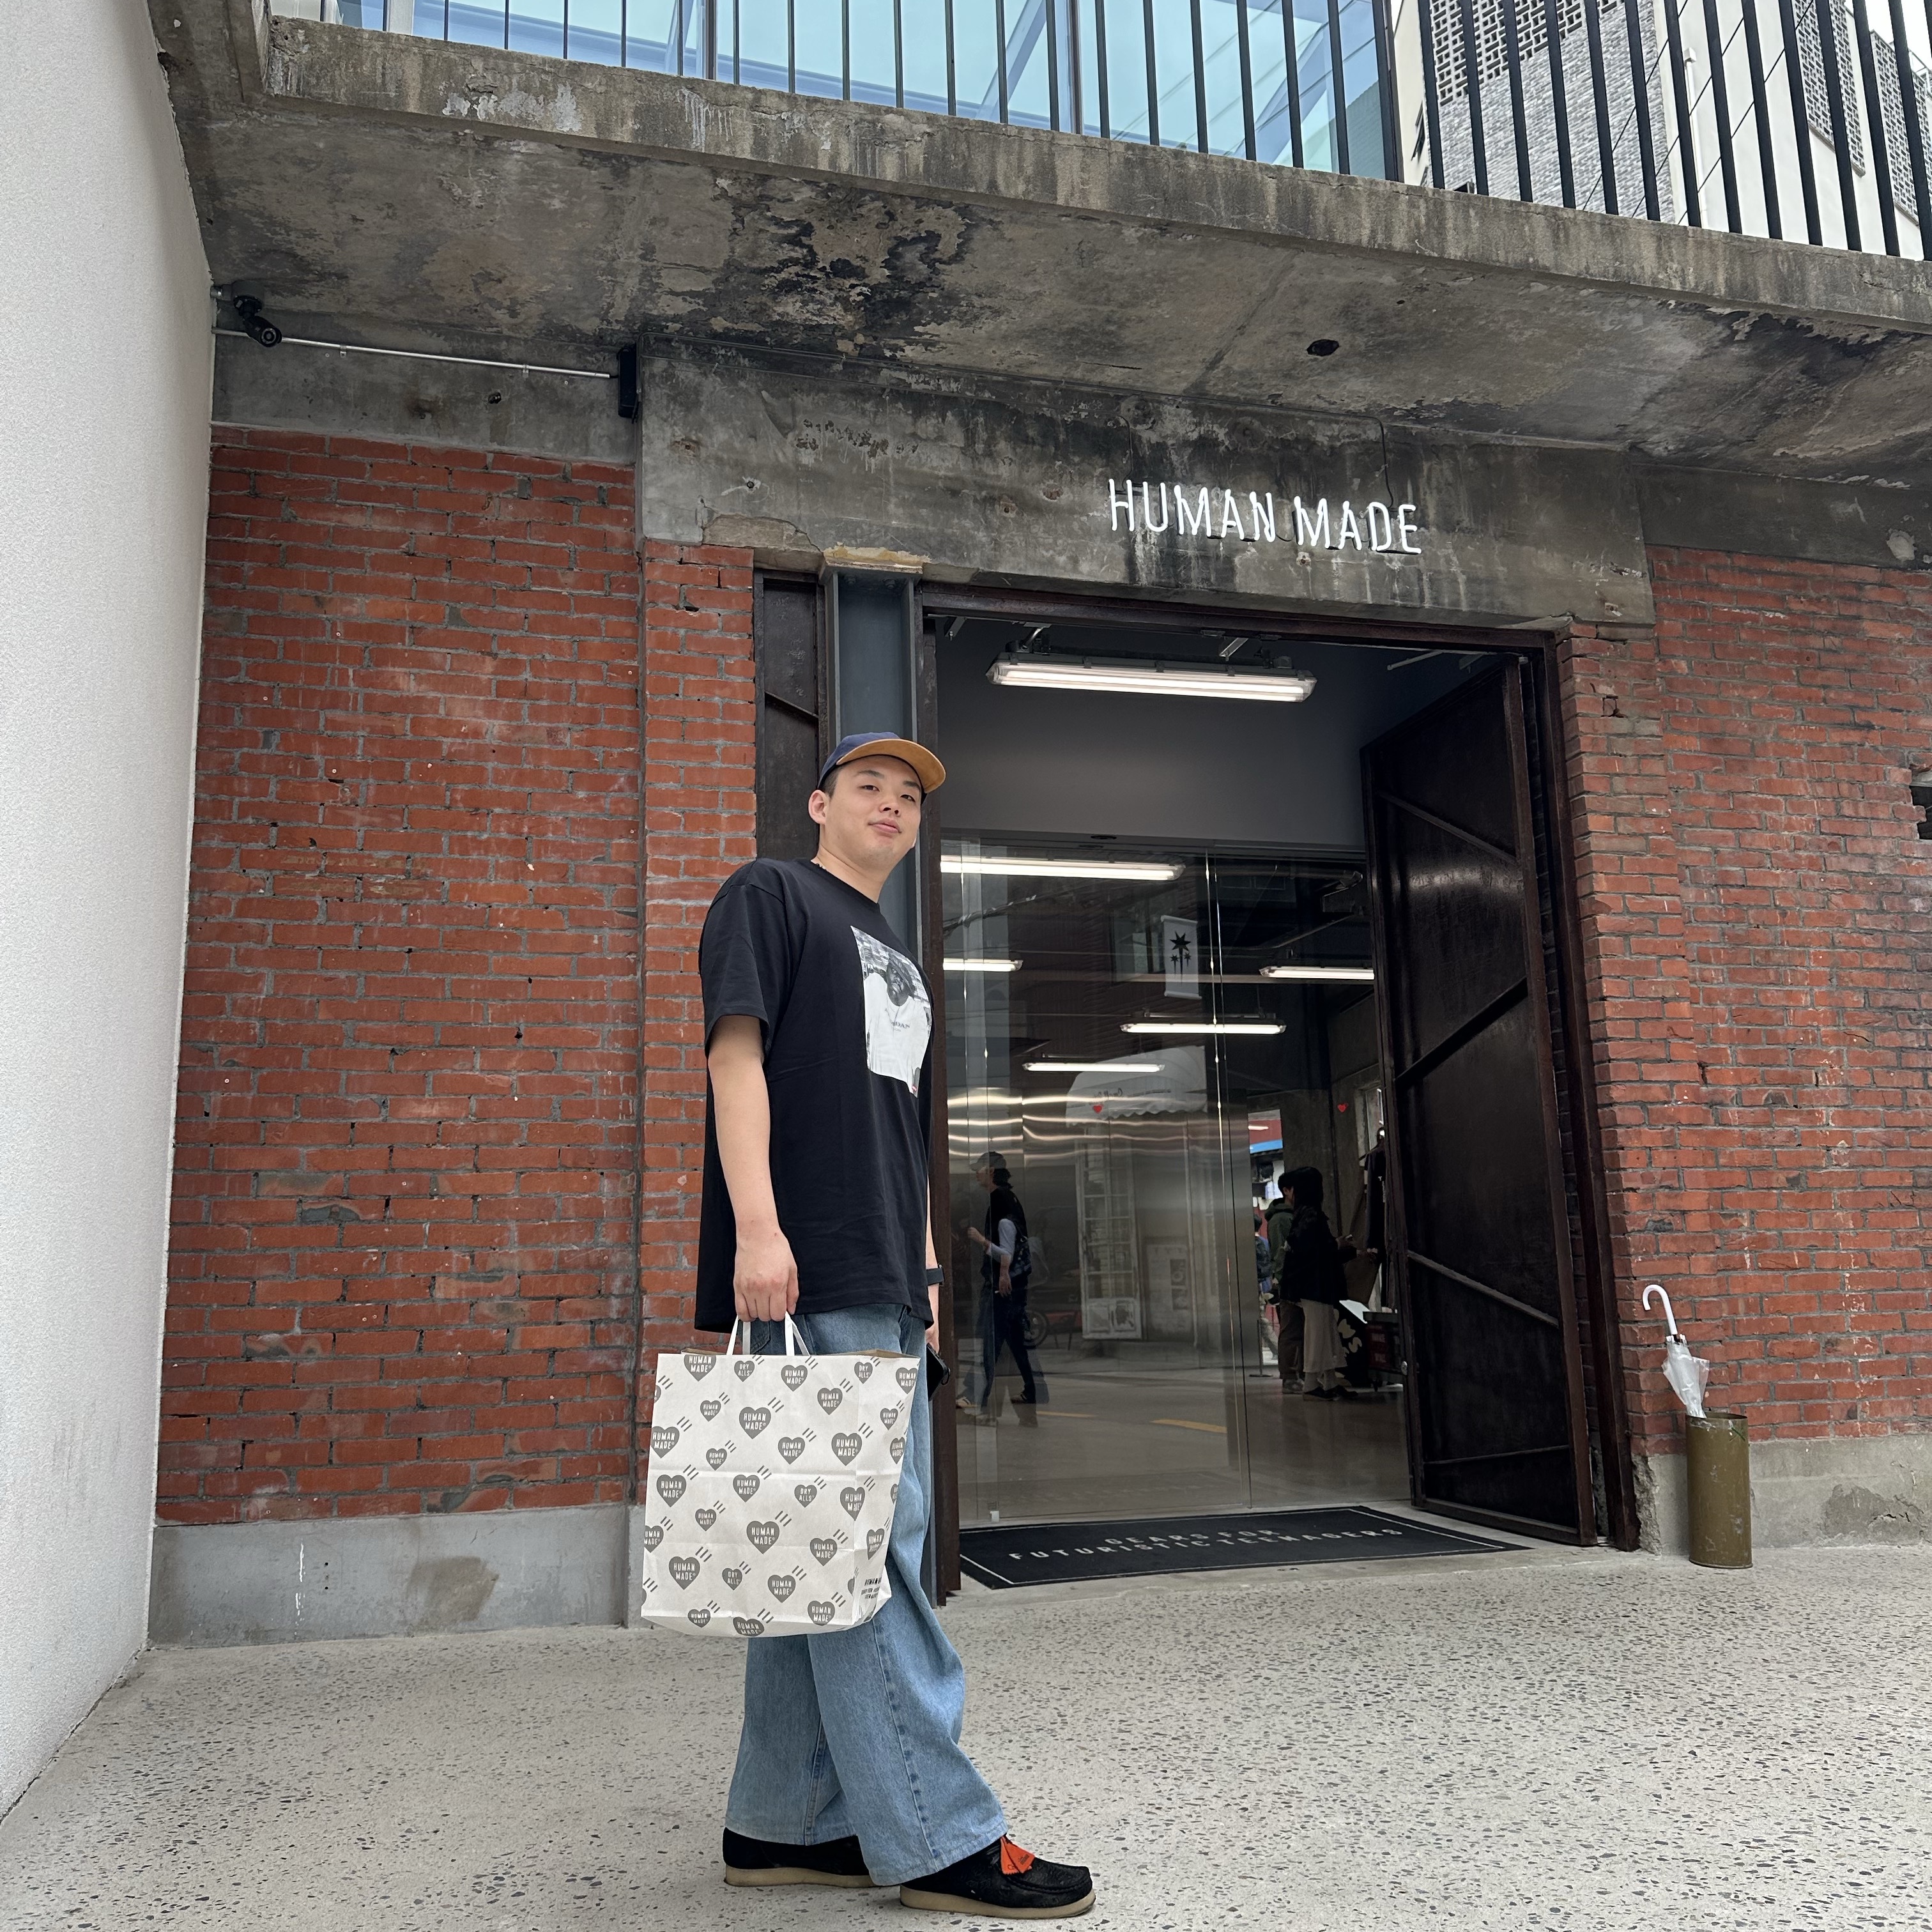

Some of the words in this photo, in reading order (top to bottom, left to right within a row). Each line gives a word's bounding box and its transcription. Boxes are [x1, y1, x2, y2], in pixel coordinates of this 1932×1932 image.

[1108, 479, 1276, 542] HUMAN
[1294, 496, 1422, 555] MADE
[751, 1527, 774, 1536] HUMAN
[1105, 1533, 1209, 1545] GEARS
[1218, 1529, 1280, 1538] FOR
[1009, 1540, 1210, 1560] FUTURISTIC
[1216, 1529, 1402, 1545] TEENAGERS
[673, 1563, 695, 1572] HUMAN
